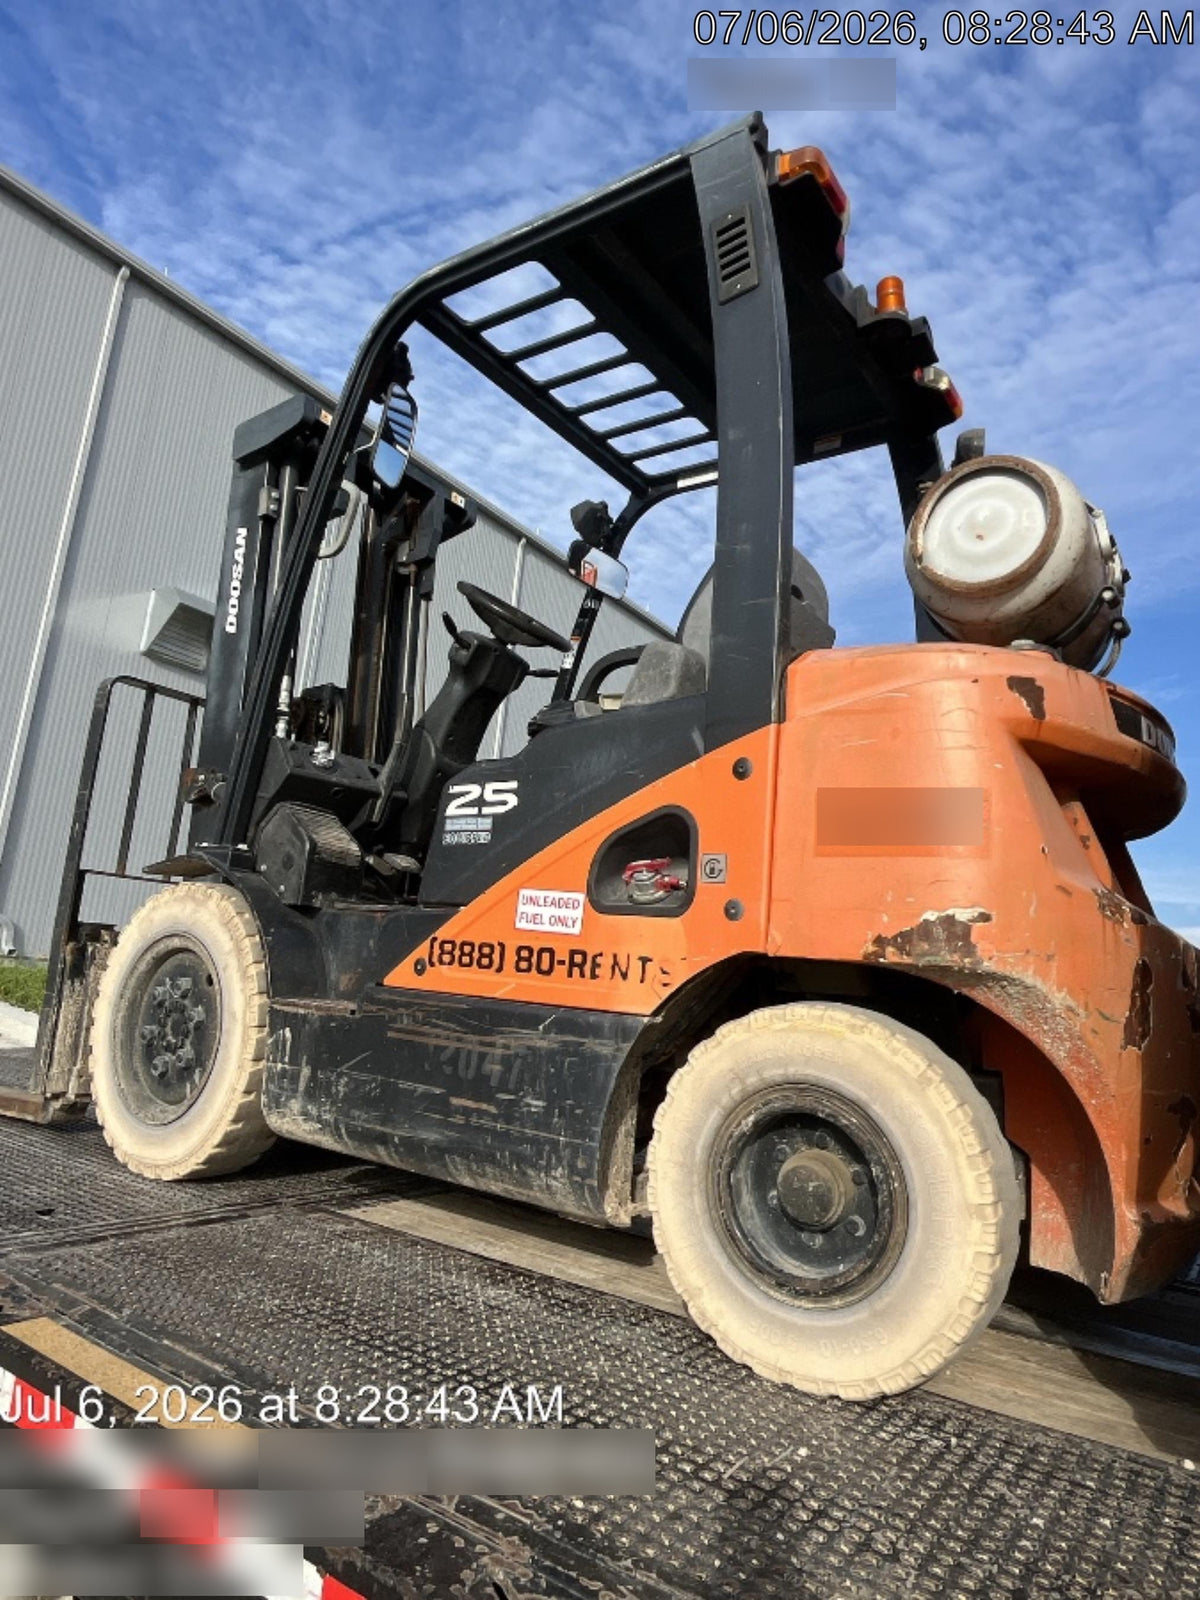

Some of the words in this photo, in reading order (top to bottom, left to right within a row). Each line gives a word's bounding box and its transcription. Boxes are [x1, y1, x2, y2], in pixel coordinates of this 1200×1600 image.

[225, 527, 248, 634] DOOSAN
[445, 780, 519, 816] 25
[521, 893, 581, 911] UNLEADED
[518, 913, 546, 926] FUEL
[548, 914, 580, 929] ONLY
[427, 936, 505, 973] (888)
